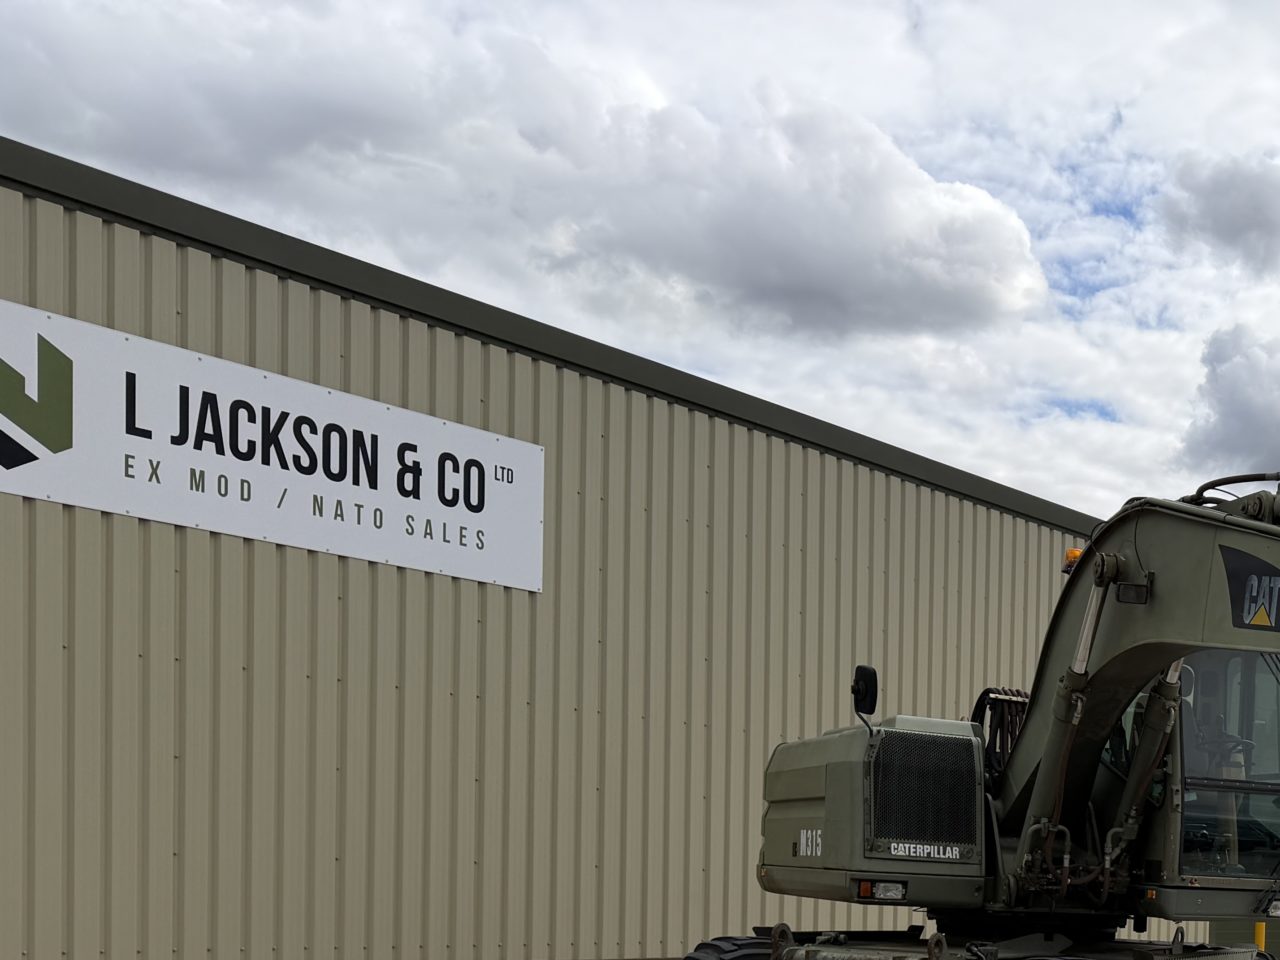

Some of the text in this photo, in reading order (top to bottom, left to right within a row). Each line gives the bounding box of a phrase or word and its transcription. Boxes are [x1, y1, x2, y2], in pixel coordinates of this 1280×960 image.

[125, 371, 514, 514] L JACKSON & CO LTD
[124, 454, 161, 485] EX
[189, 468, 251, 502] MOD
[312, 494, 383, 529] NATO
[405, 515, 485, 550] SALES
[800, 829, 822, 857] M315
[890, 843, 960, 859] CATERPILLAR
